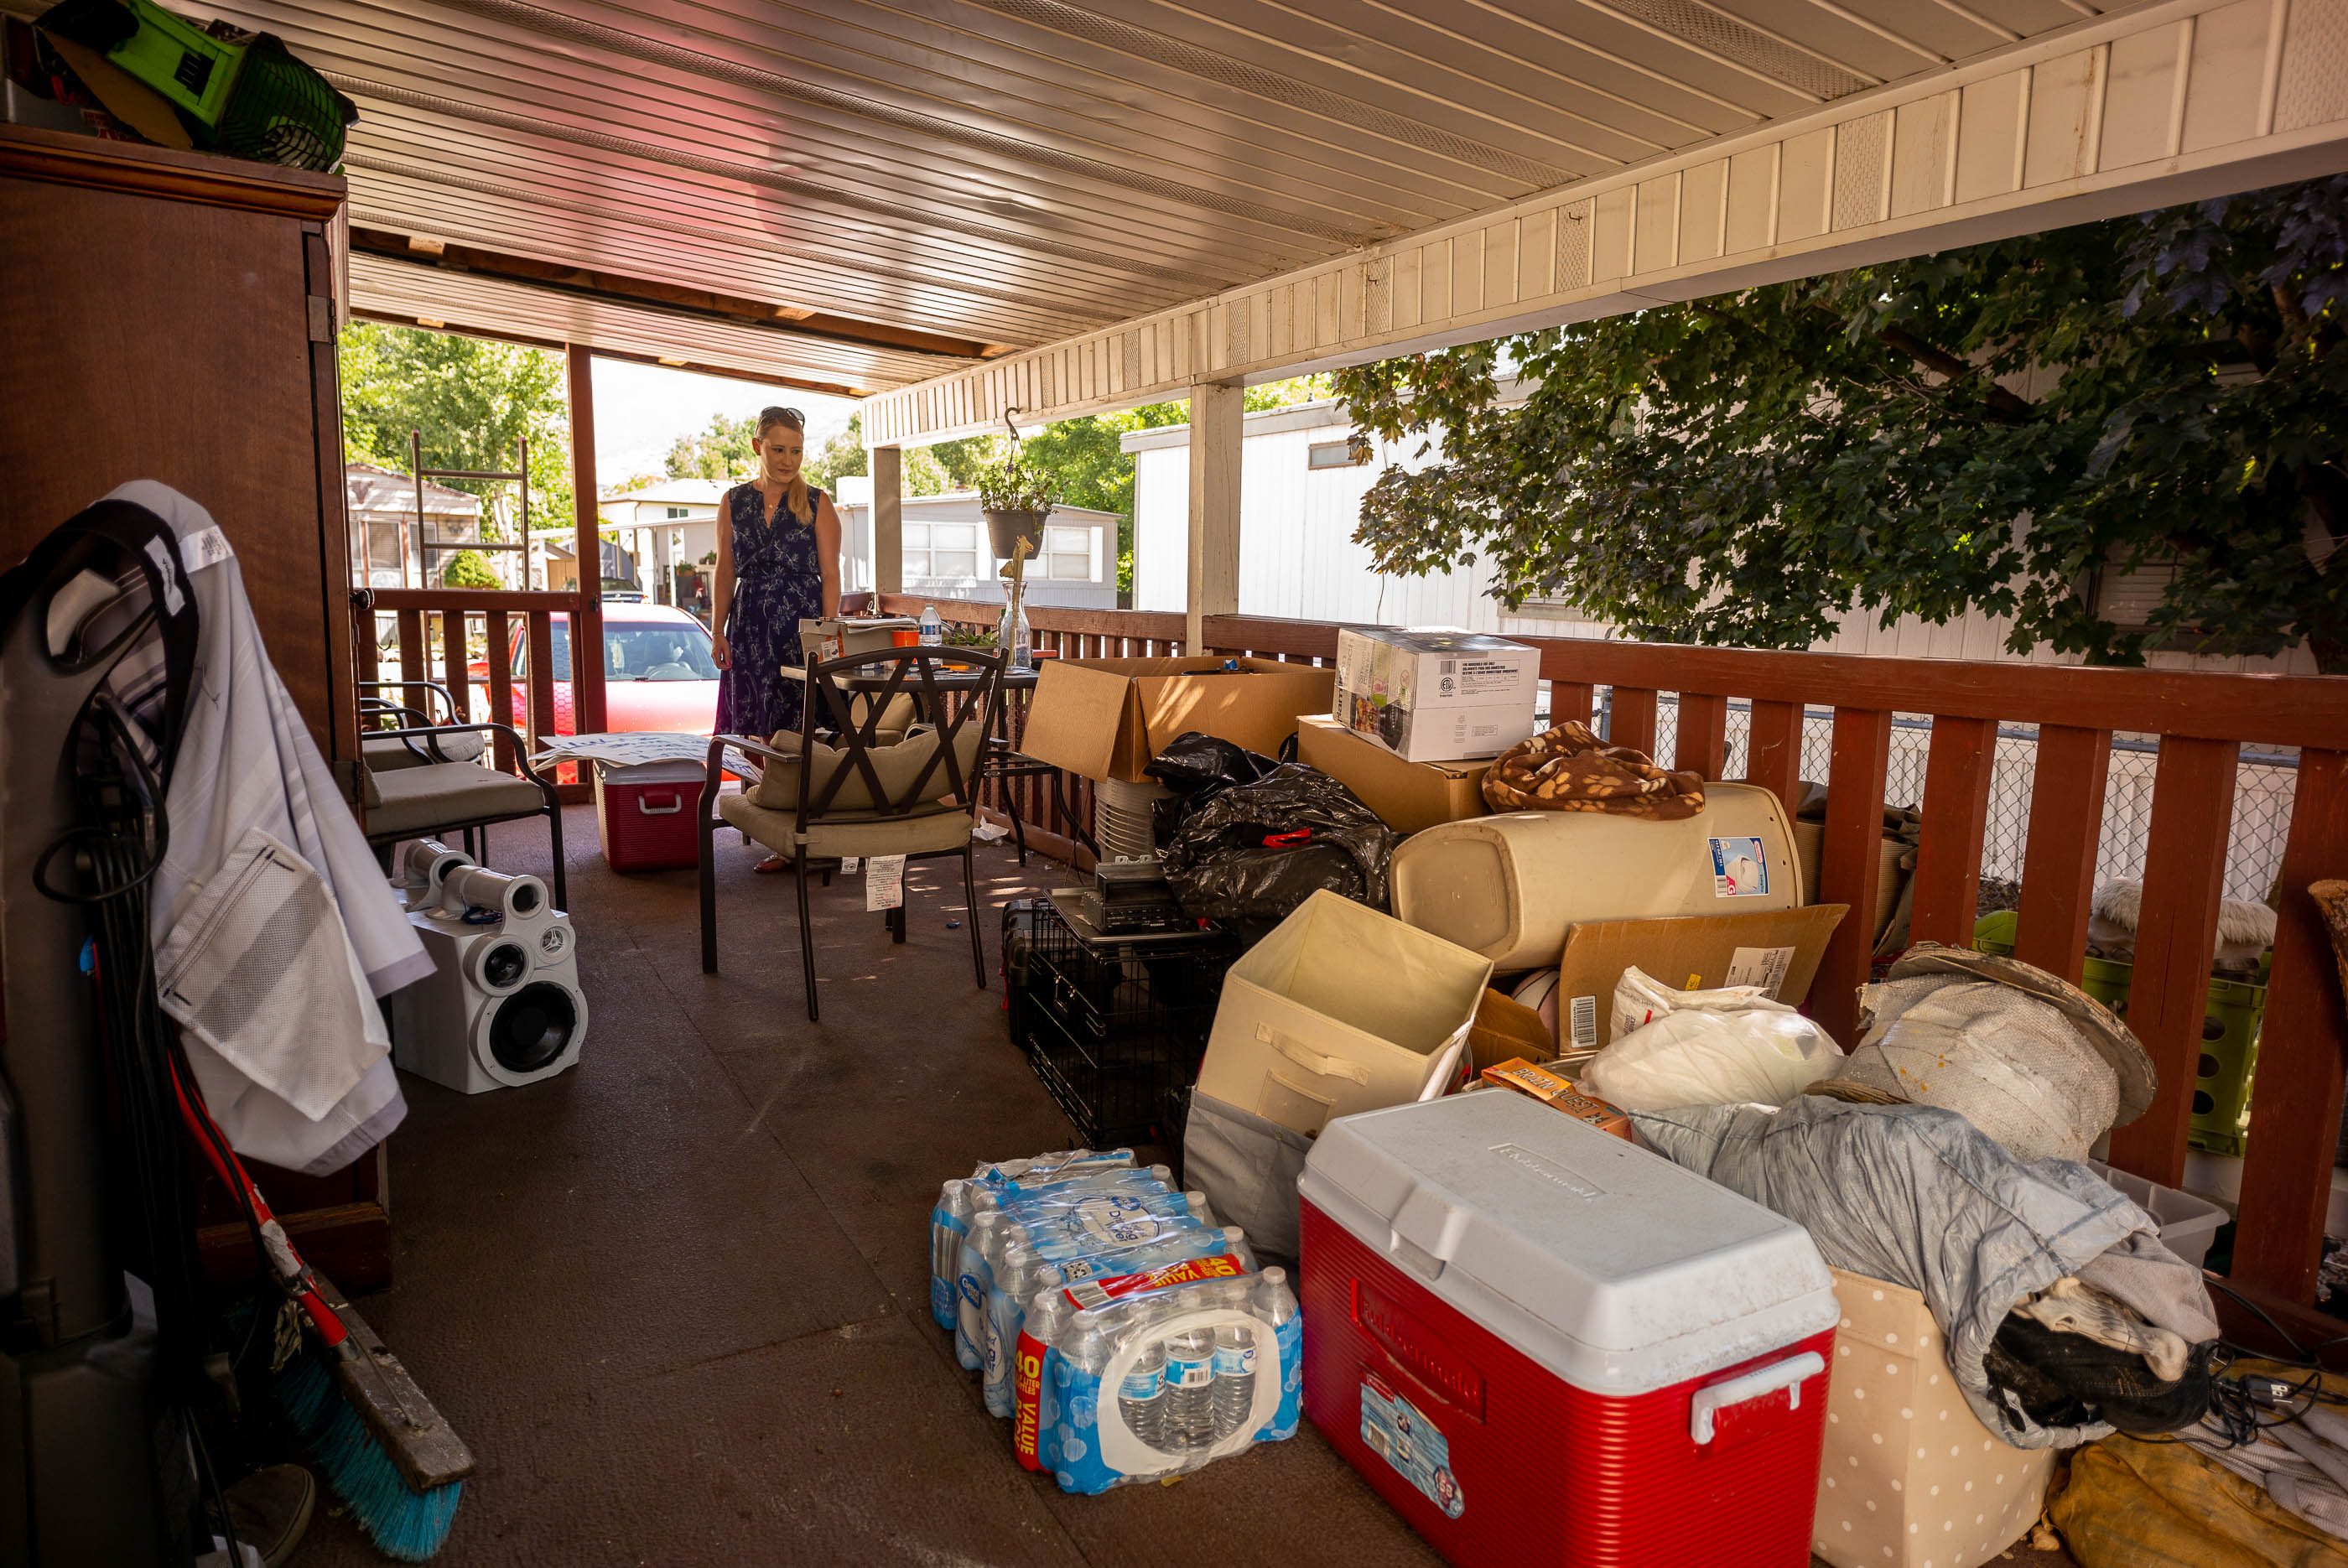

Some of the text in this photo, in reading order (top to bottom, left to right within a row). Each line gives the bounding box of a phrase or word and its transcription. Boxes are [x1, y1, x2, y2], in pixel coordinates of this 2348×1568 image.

[1510, 1067, 1557, 1089] BRAIN
[1551, 1088, 1599, 1111] QUEST
[1016, 1349, 1040, 1378] 40
[1021, 1403, 1036, 1456] VALUE
